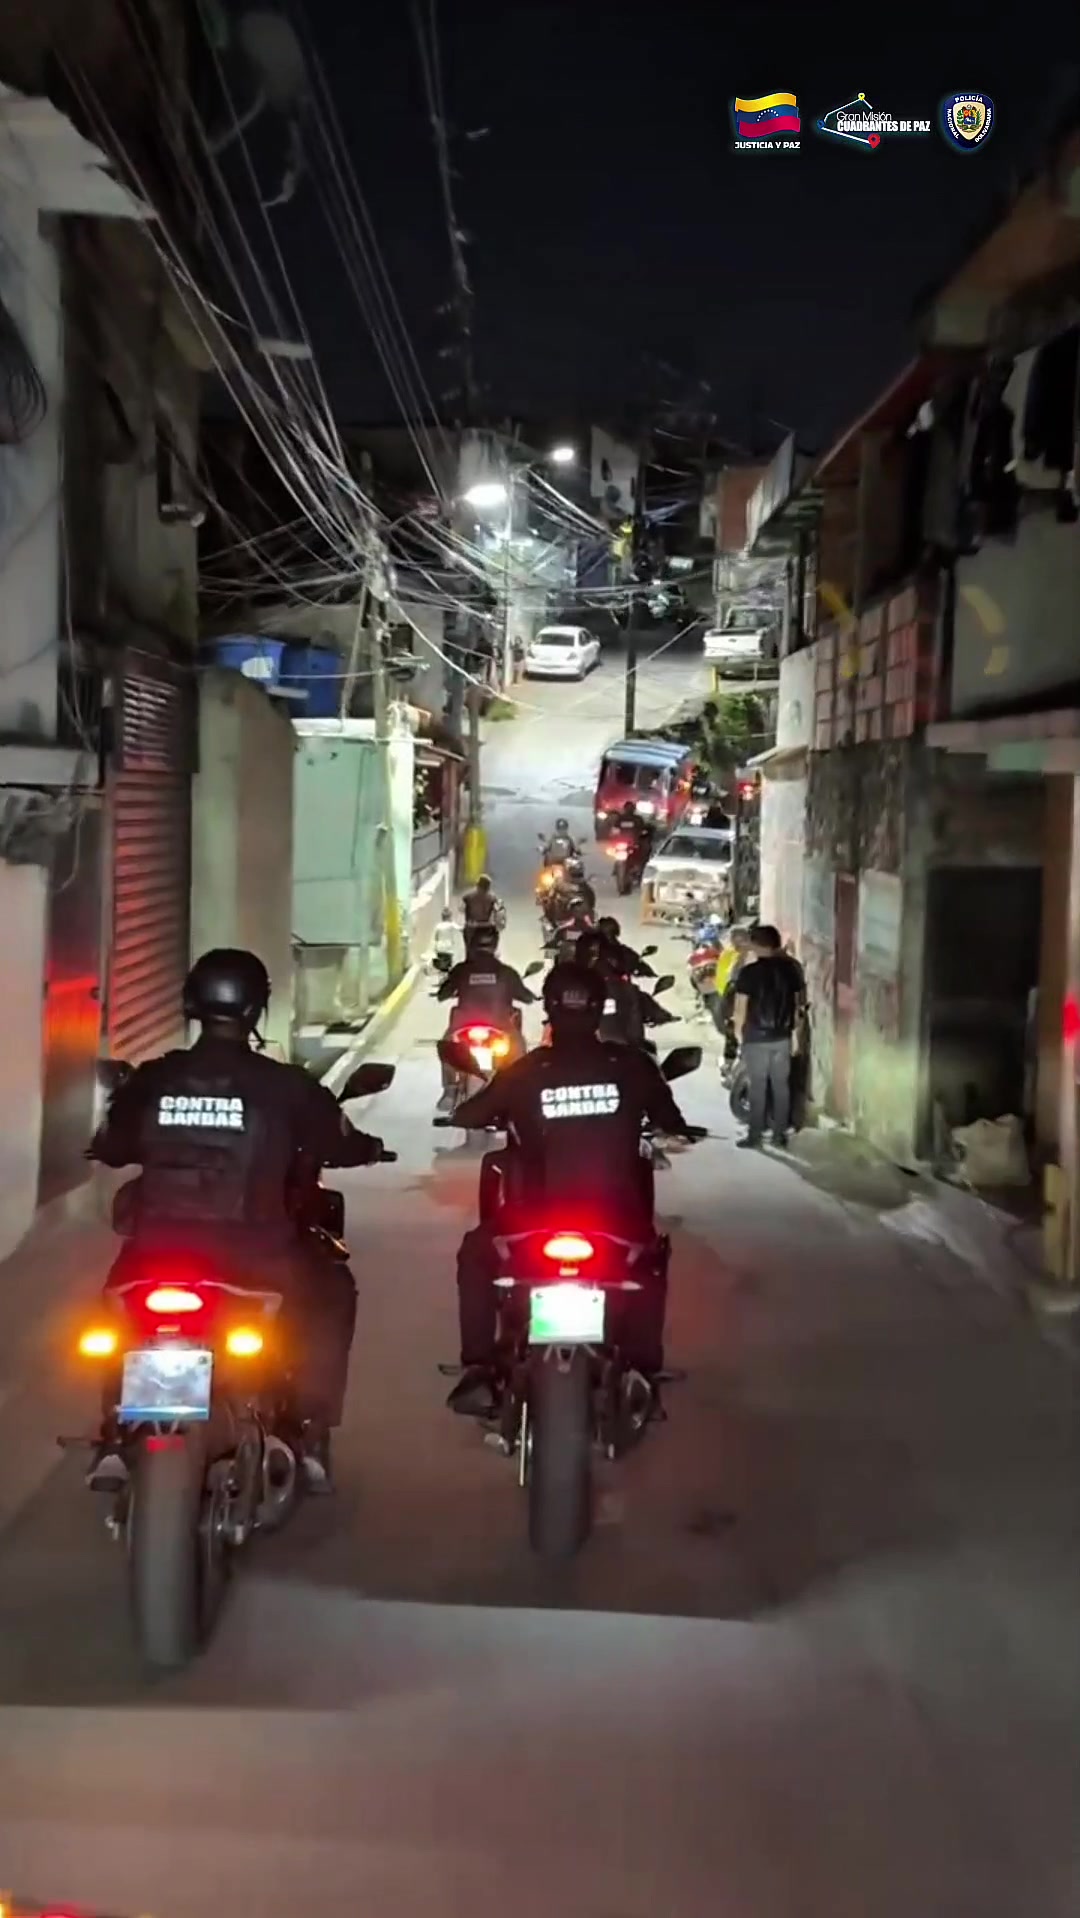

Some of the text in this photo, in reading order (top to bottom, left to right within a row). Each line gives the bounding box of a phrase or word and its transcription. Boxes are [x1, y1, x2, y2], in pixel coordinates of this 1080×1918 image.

[540, 1083, 620, 1104] CONTRA
[159, 1095, 244, 1112] CONTRA
[158, 1110, 244, 1128] BANDAS
